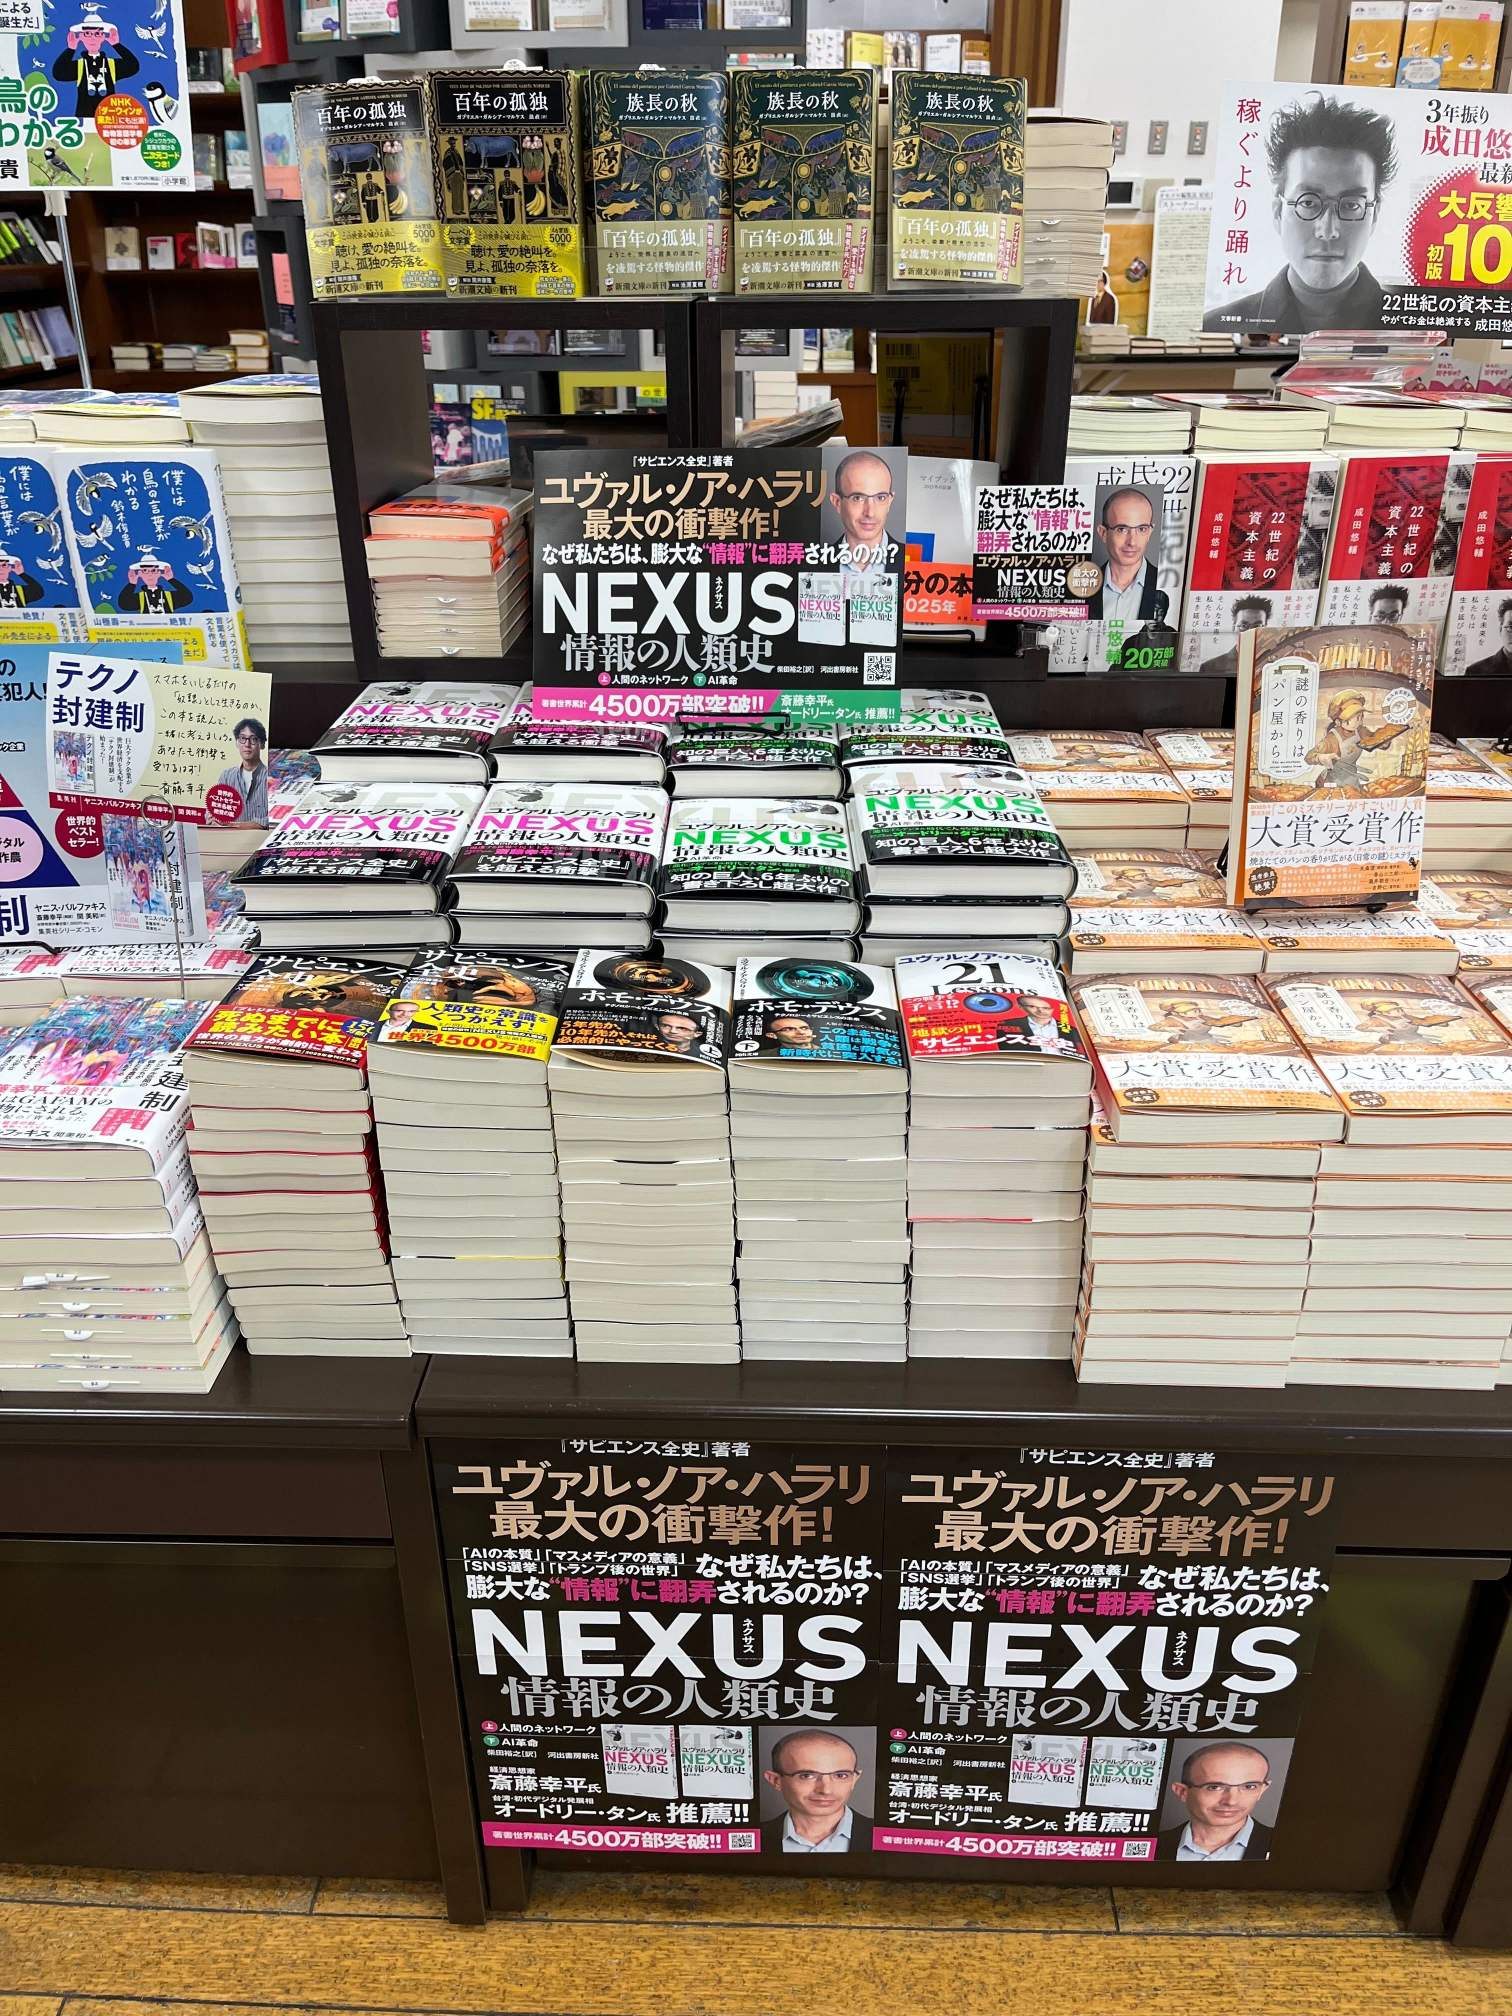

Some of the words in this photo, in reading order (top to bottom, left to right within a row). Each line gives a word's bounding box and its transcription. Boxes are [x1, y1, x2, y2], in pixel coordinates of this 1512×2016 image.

[453, 91, 548, 112] 百年の孤独
[626, 93, 698, 112] 族長の秋
[767, 91, 839, 111] 族長の秋
[926, 92, 994, 113] 族長の秋
[316, 101, 407, 125] 百年の孤独
[1426, 99, 1490, 125] 3年振り
[1, 159, 19, 178] 貴
[1221, 98, 1262, 285] 稼ぐより踊れ
[549, 234, 572, 243] 5000
[740, 228, 841, 249] 『百年の孤独』
[1425, 244, 1444, 280] 初版
[632, 456, 734, 467] 『サピエンス全史』著者
[10, 465, 34, 502] 僕には
[121, 469, 140, 511] わかる
[163, 469, 187, 506] 僕には
[540, 470, 827, 508] ユヴァル・ノア・ハラリ
[143, 469, 170, 542] 鳥の言葉が
[978, 488, 1085, 509] なぜ私たちは、
[583, 508, 780, 541] 最大の衝撃作!
[1347, 507, 1364, 555] 成田悠輔
[1474, 511, 1488, 558] 成田悠輔
[977, 531, 1091, 552] 翻弄されるのか?
[1208, 512, 1224, 559] 成田悠輔
[1240, 511, 1262, 580] 資本主義
[1263, 511, 1286, 579] 22世紀の
[1378, 505, 1401, 575] 資本主義
[1400, 505, 1424, 574] 22世紀の
[997, 569, 1066, 586] NEXUS
[1072, 579, 1098, 587] 衝撃作
[1073, 569, 1098, 578] 最大の
[714, 576, 724, 609] ネクサス
[997, 586, 1065, 598] 情報の人類史
[543, 571, 795, 635] NEXUS
[800, 600, 840, 612] NEXUS
[851, 601, 892, 613] NEXUS
[560, 633, 774, 674] 情報の人類史
[1124, 647, 1153, 669] 20
[56, 661, 139, 695] テクノ
[154, 674, 236, 691] スマホをいじるだけの
[611, 674, 689, 686] 人間のネットワーク
[707, 675, 738, 686] AI革命
[52, 695, 145, 733] 封建制
[347, 704, 501, 720] NEXUS
[1270, 678, 1286, 758] パン屋から
[1293, 677, 1309, 758] 謎の香りは
[866, 795, 1044, 814] NEXUS
[66, 815, 96, 826] 世界的
[280, 815, 459, 833] NEXUS
[477, 815, 654, 834] NEXUS
[869, 810, 1050, 826] 情報の人類史
[69, 826, 96, 837] ベスト
[273, 830, 450, 844] 情報の人類史
[473, 830, 652, 846] 情報の人類史
[674, 831, 847, 848] NEXUS
[1248, 811, 1423, 849] 大賞受賞作
[68, 838, 100, 848] セラー!
[672, 845, 849, 861] 情報の人類史
[875, 837, 1060, 850] 知の巨人、6年ぶりの
[264, 858, 417, 869] 『サピエンス全史』
[477, 855, 631, 870] 『サピエンス全史』
[670, 872, 850, 887] 知の巨人、6年ぶりの
[682, 880, 838, 894] 書き下ろし超大作
[34, 903, 107, 912] ヤニス・バルファキス
[259, 955, 408, 978] サピエンス
[419, 950, 570, 977] サピエンス
[898, 952, 1050, 967] ユヴァル・ノア・ハラリ
[408, 963, 479, 982] 全史
[943, 962, 1014, 985] 21
[579, 990, 716, 1018] ホモ・デウス
[748, 1001, 887, 1021] ホモ・デウス
[429, 1013, 535, 1031] くつがえす!
[919, 1034, 1077, 1051] サピエンス全史
[560, 1440, 751, 1458] 『サピエンス全史』著者
[1018, 1449, 1216, 1469] 『サピエンス全史』著者
[452, 1460, 870, 1503] ユヴァル・ノア・ハラリ
[902, 1469, 1335, 1516] ユヴァル・ノア・ハラリ
[490, 1500, 833, 1546] 最大の衝撃作!
[934, 1511, 1287, 1556] 最大の衝撃作!
[696, 1552, 884, 1580] なぜ私たちは、
[1139, 1565, 1331, 1592] なぜ私たちは、
[471, 1609, 866, 1681] NEXUS
[742, 1618, 755, 1654] ネクサス
[897, 1620, 1300, 1693] NEXUS
[1171, 1630, 1187, 1666] ネクサス
[501, 1676, 839, 1721] 情報の人類史
[915, 1685, 1259, 1733] 情報の人類史
[499, 1723, 597, 1735] 人間のネットワーク
[908, 1731, 1007, 1744] 人間のネットワーク
[501, 1736, 538, 1748] AI革命
[908, 1745, 946, 1755] AI革命
[605, 1752, 668, 1766] NEXUS
[682, 1754, 745, 1766] NEXUS
[1012, 1761, 1076, 1776] NEXUS
[1091, 1765, 1154, 1778] NEXUS
[554, 1829, 722, 1850] 4500万部突破!!
[945, 1836, 1115, 1858] 4500万部突破!!
